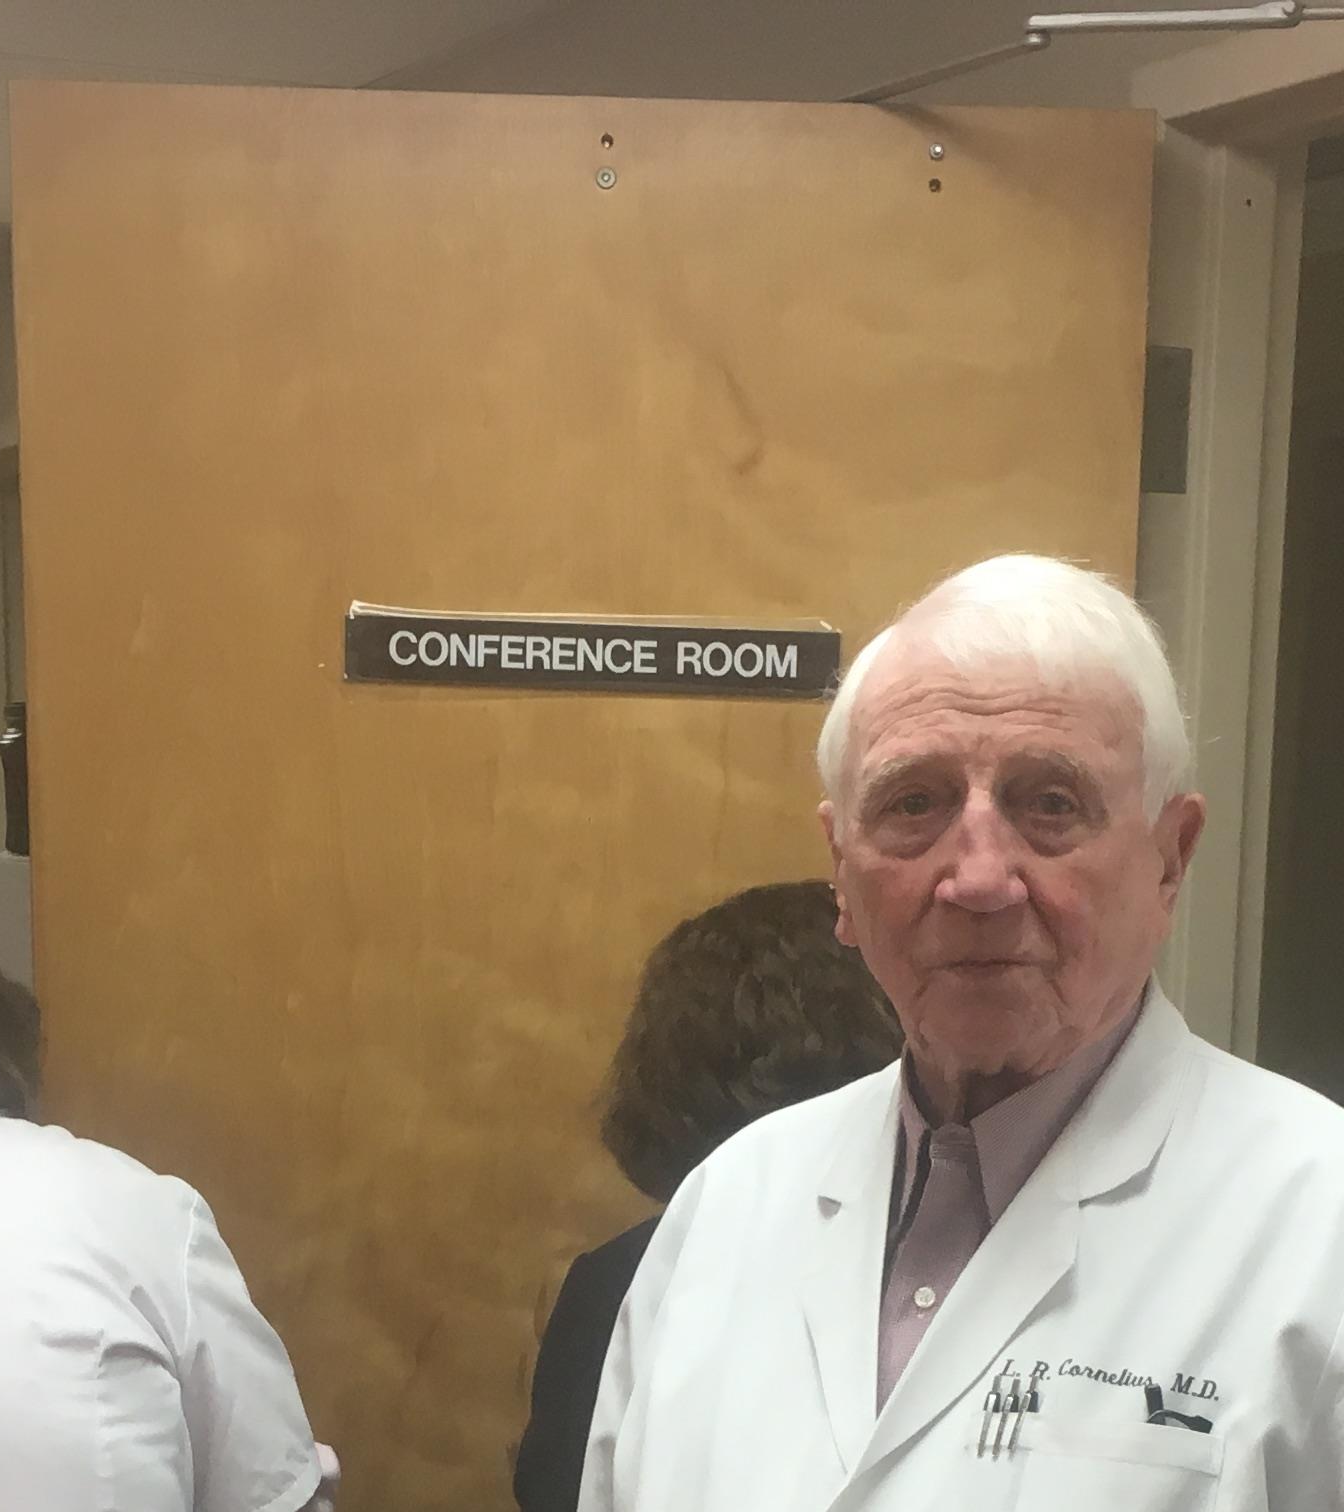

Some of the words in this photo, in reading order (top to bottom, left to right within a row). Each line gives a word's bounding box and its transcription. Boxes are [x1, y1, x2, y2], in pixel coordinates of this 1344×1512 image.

[388, 630, 657, 674] CONFERENCE
[676, 641, 798, 678] ROOM
[1000, 1359, 1021, 1378] L.
[1170, 1373, 1221, 1401] M.D.
